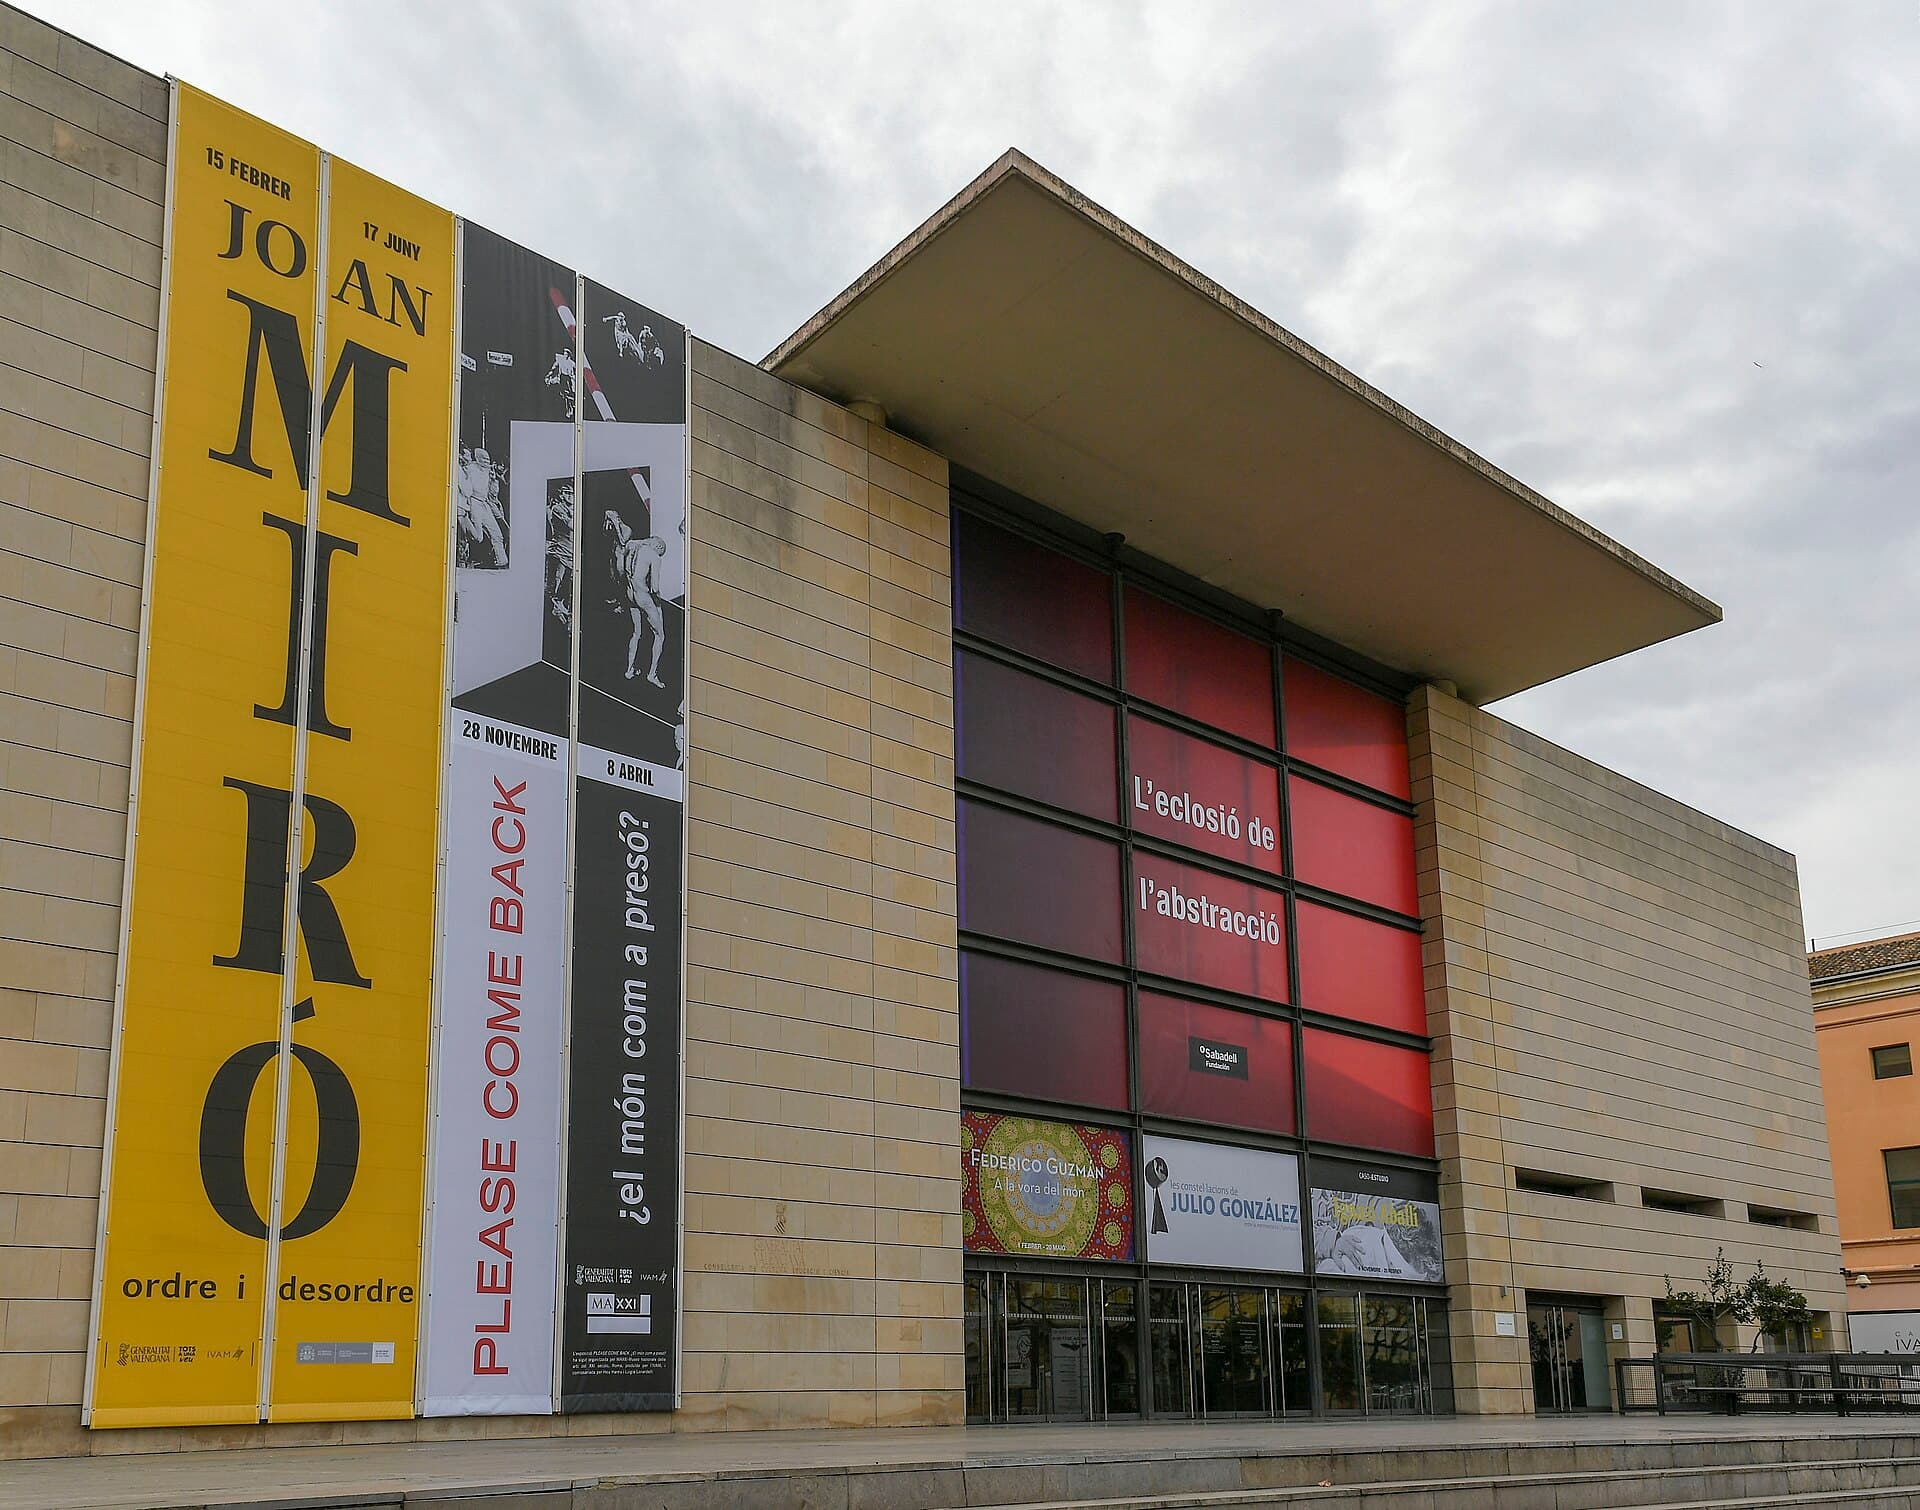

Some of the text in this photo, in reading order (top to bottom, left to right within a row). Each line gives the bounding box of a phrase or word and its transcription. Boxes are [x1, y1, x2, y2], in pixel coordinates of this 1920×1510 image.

[206, 147, 292, 201] 15 FEBRER
[363, 221, 421, 261] 17 JUNY
[462, 719, 558, 761] 28 NOVEMBRE
[607, 759, 655, 787] 8 ABRIL
[1134, 775, 1275, 851] L'eclosió de
[618, 810, 656, 933] presó?
[1140, 877, 1279, 945] l'abstracció
[624, 943, 648, 967] a
[622, 979, 648, 1059] com
[473, 774, 527, 1376] PLEASE COME BACK
[613, 1071, 647, 1156] món
[994, 1178, 1084, 1197] A la vora del món
[1171, 1192, 1299, 1224] JULIO GONZÁLEZ
[122, 1272, 415, 1303] ordre i desordre
[640, 1273, 659, 1281] IVAM
